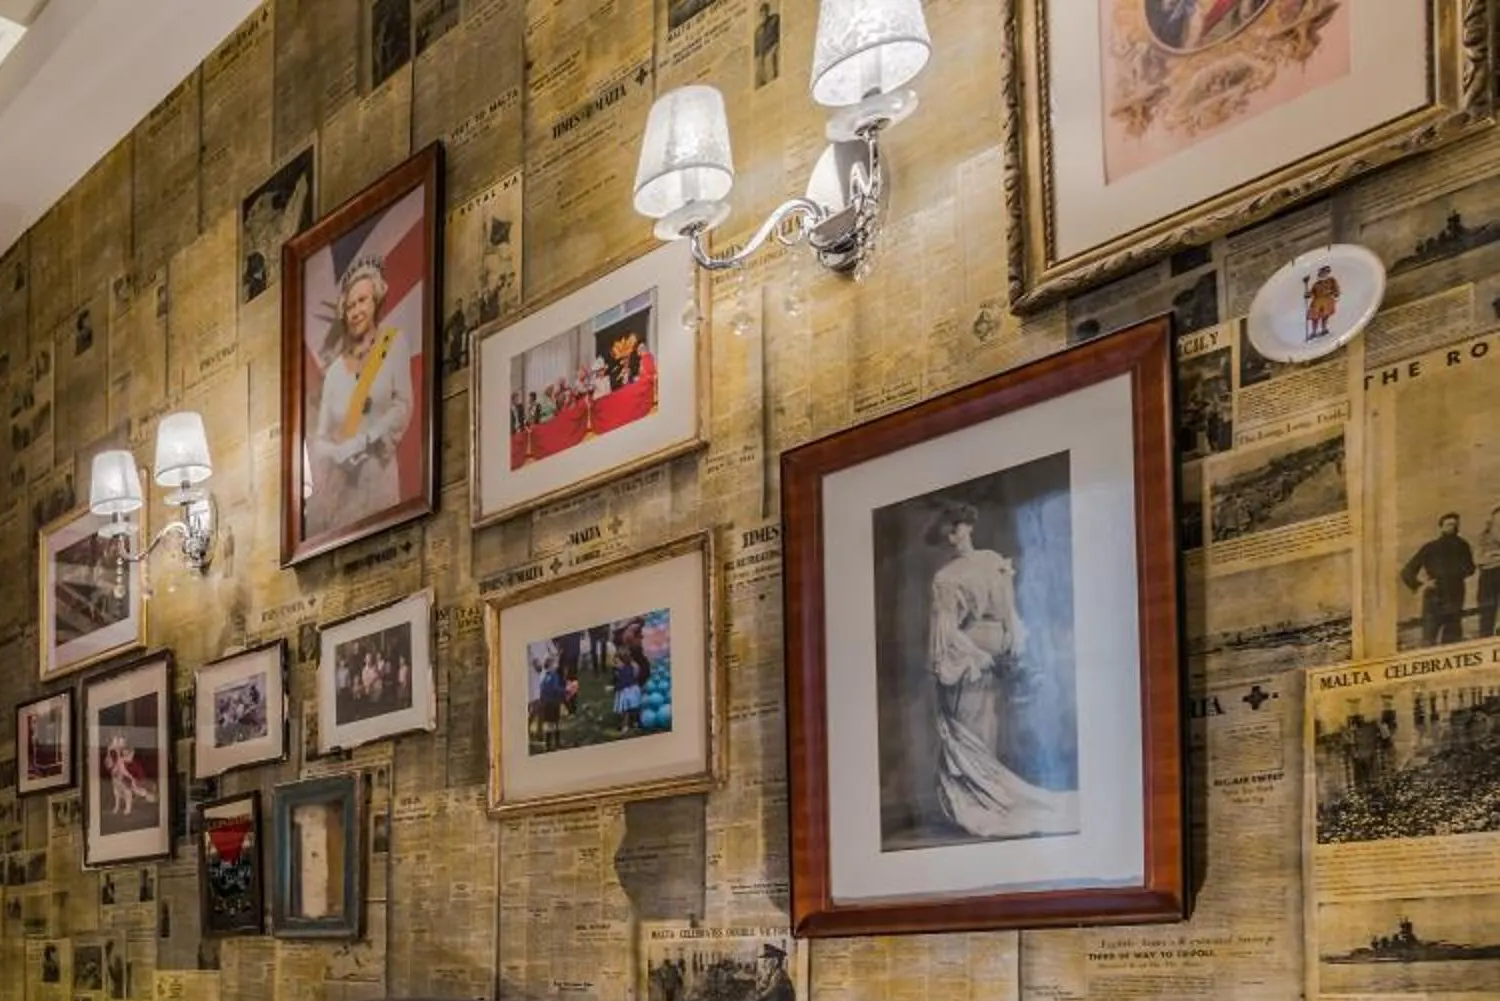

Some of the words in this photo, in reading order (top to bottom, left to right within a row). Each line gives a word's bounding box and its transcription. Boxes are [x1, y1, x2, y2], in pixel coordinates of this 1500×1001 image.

[552, 114, 582, 139] TIMES
[595, 83, 628, 111] MALTA
[1363, 360, 1421, 392] THE
[1320, 670, 1373, 690] MALTA
[1384, 650, 1484, 680] CELEBRATES
